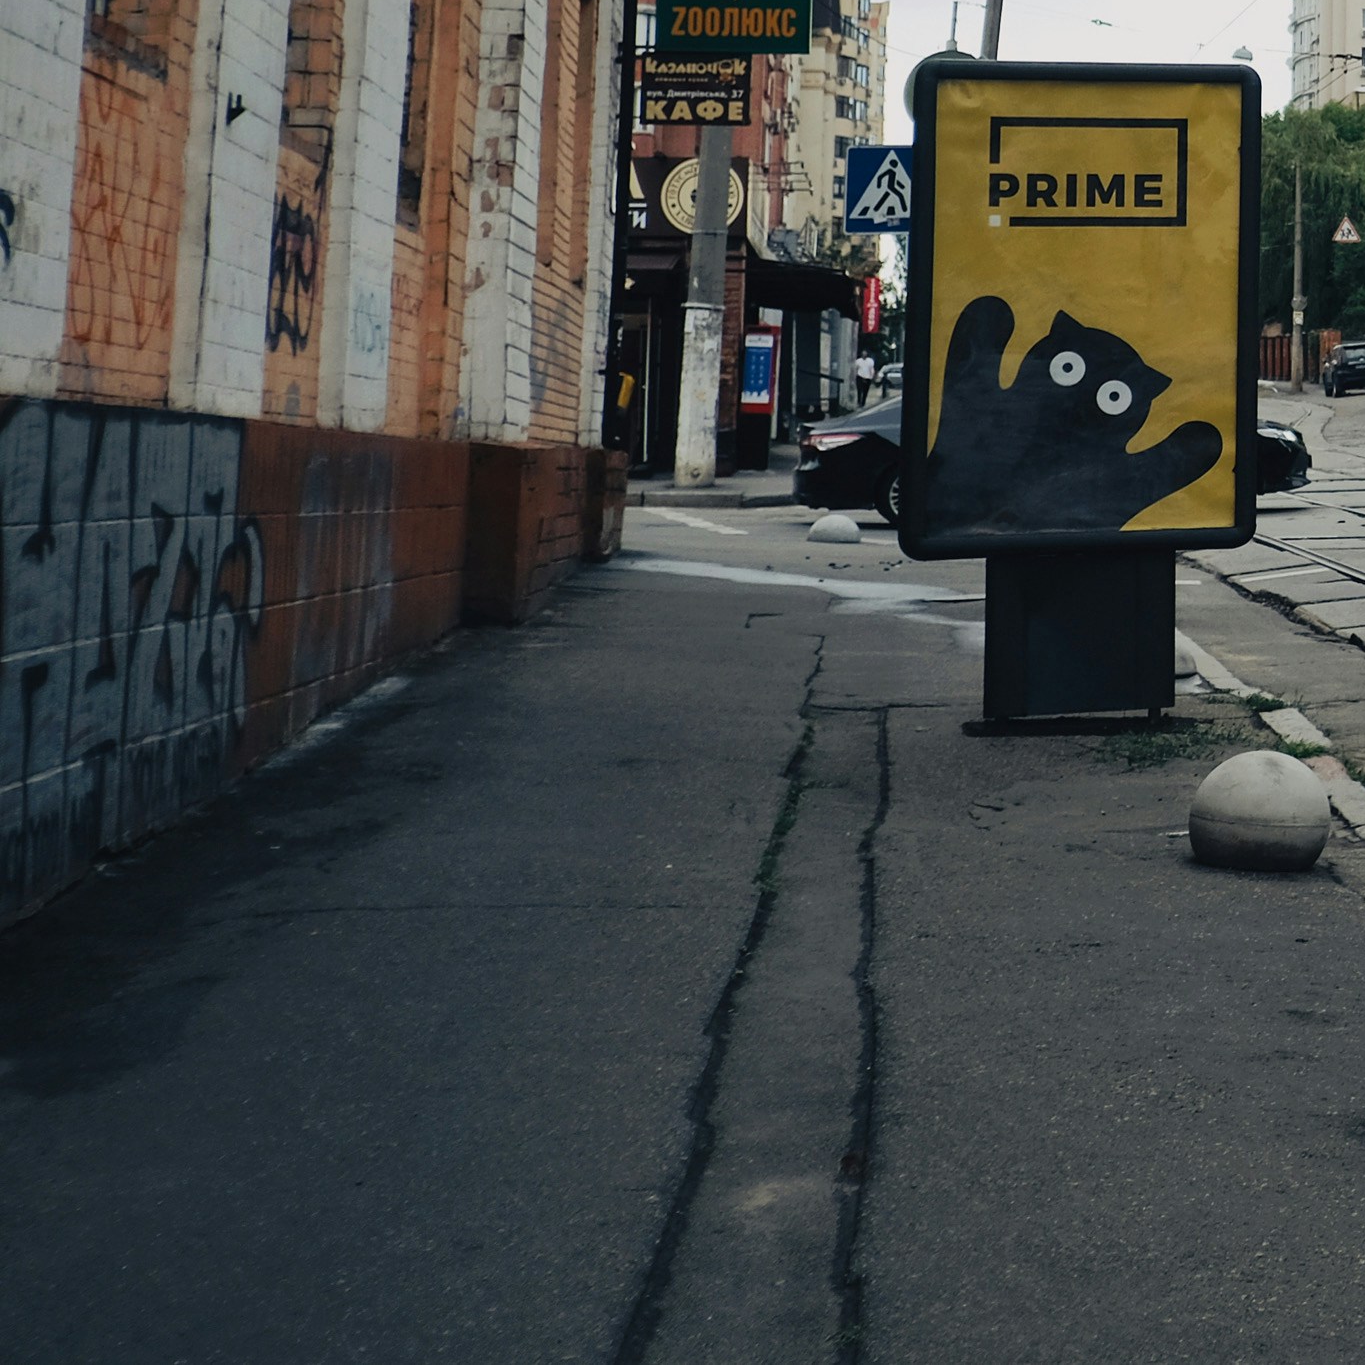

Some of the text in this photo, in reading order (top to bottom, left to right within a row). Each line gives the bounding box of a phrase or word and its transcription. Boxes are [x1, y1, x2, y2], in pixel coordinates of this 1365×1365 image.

[731, 89, 744, 98] 37
[646, 99, 744, 121] КАФЕ
[988, 172, 1164, 208] PRIME
